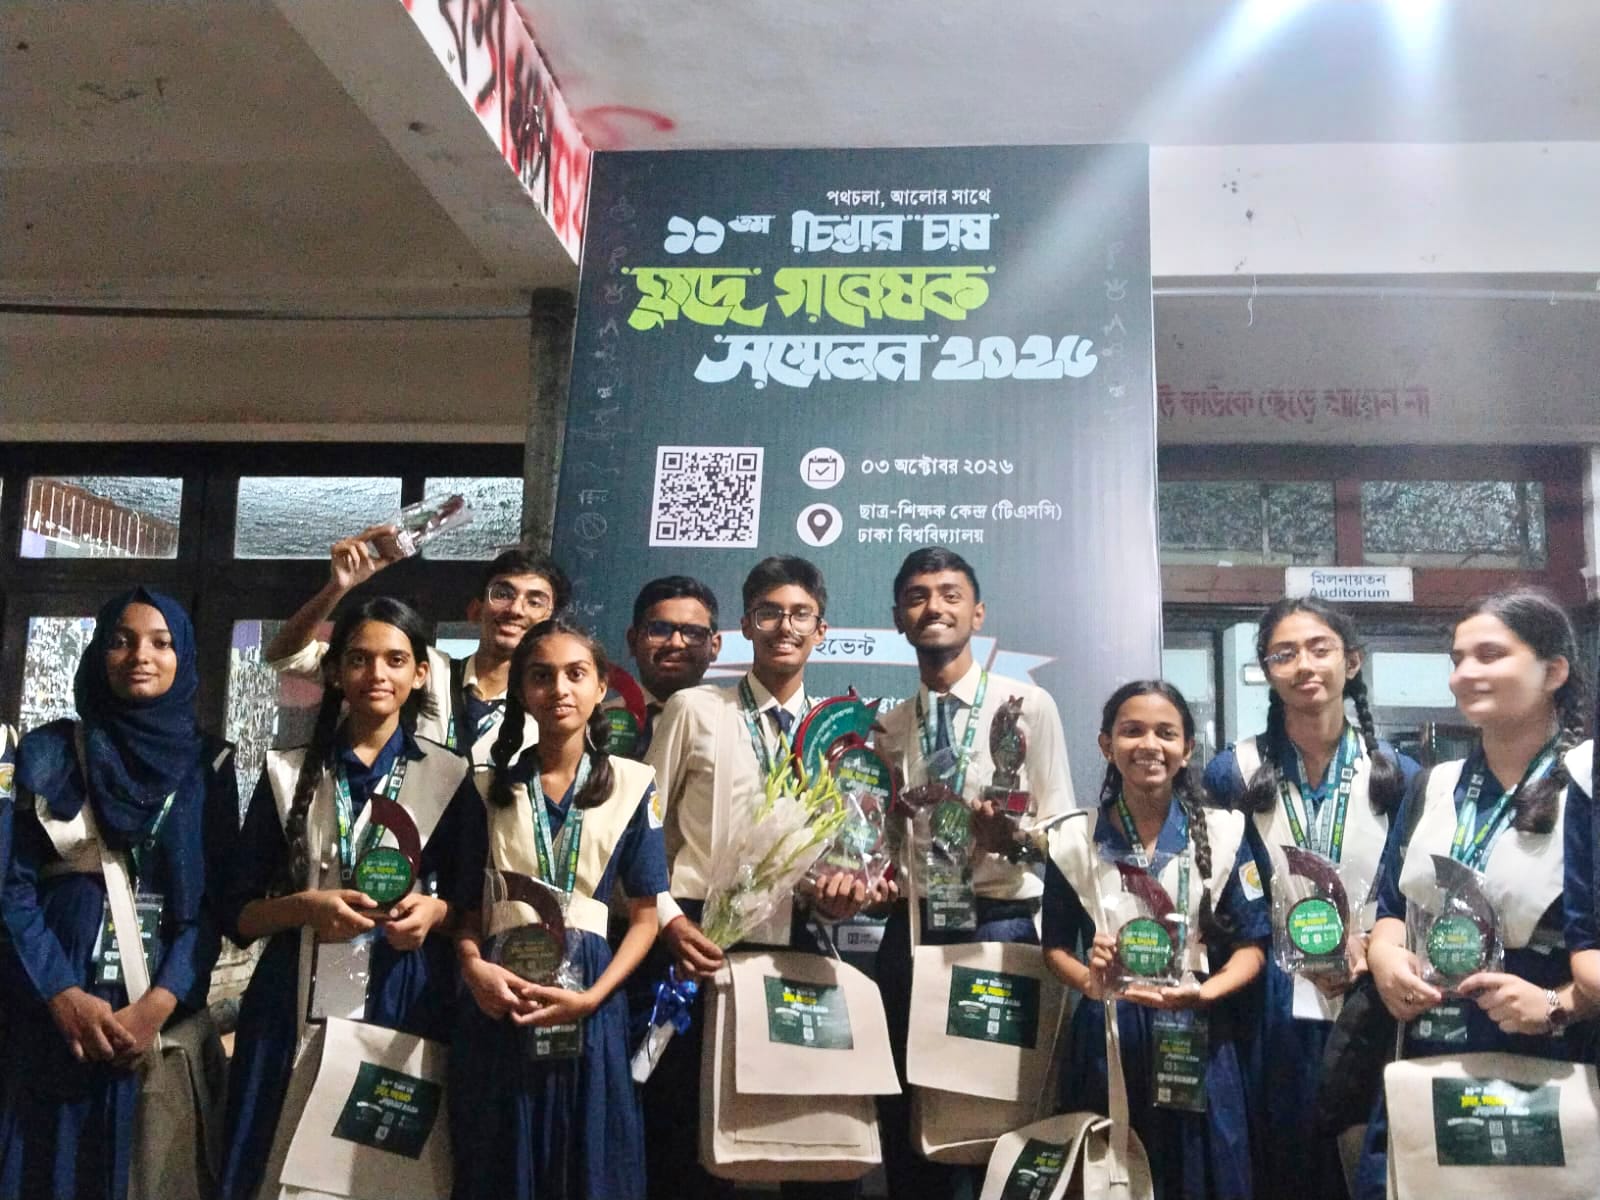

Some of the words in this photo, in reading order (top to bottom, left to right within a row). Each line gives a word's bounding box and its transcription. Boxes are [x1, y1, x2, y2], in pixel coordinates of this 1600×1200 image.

[826, 188, 885, 208] পথচলা,
[890, 188, 948, 206] আলোর
[951, 188, 991, 205] সাথে
[791, 209, 914, 254] চিন্তার
[918, 213, 1000, 252] চাষ
[621, 266, 769, 331] ক্ষুদে
[774, 265, 997, 328] গবেষক
[693, 334, 939, 390] সম্মেলন
[861, 459, 889, 474] ০৩
[894, 454, 959, 476] অক্টোবর
[963, 459, 1014, 475] ২০২৬
[859, 499, 946, 520] ছাত্র-শিক্ষক
[950, 504, 988, 520] কেন্দ্র
[991, 499, 1063, 521] (টিএসসি)
[858, 527, 892, 543] ঢাকা
[897, 523, 985, 544] বিশ্ববিদ্যালয়
[1311, 570, 1387, 586] মিলনায়তন
[1309, 587, 1390, 599] Auditorium
